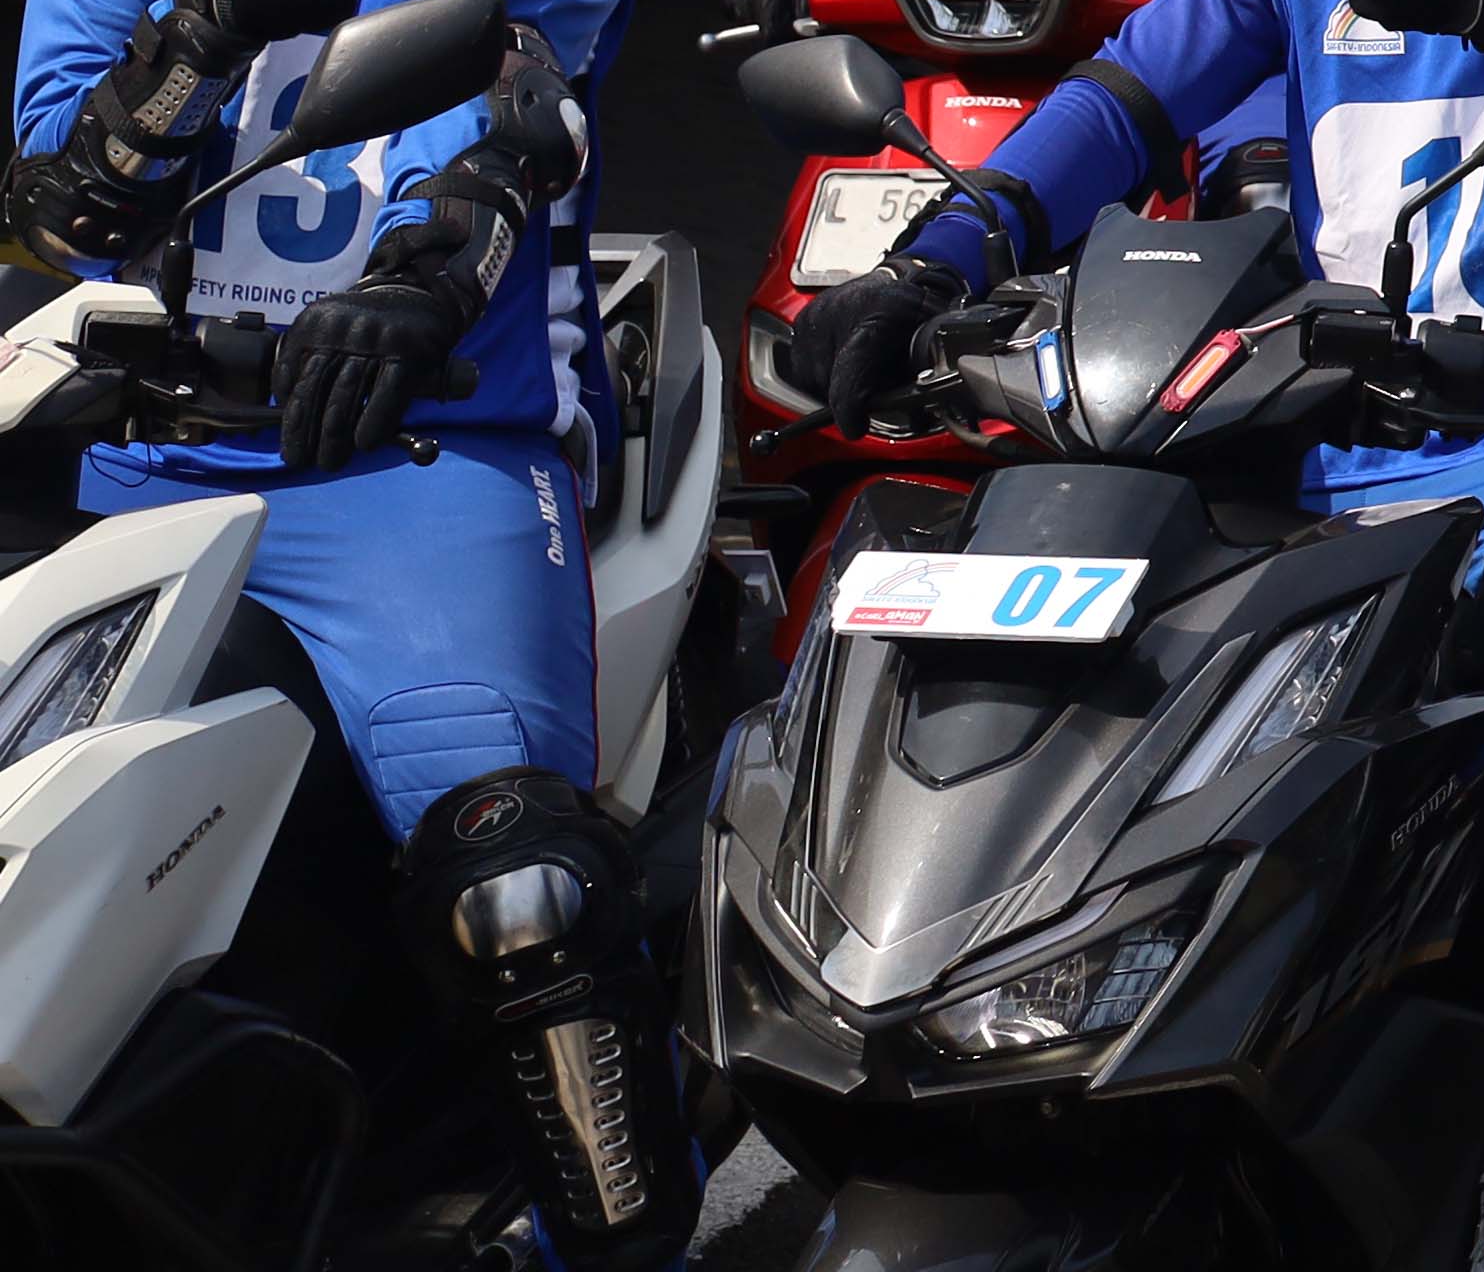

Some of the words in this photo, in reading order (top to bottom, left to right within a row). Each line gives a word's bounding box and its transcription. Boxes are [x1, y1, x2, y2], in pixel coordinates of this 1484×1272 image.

[944, 96, 1023, 109] HONDA
[193, 34, 363, 263] 13
[824, 188, 846, 223] L
[1123, 250, 1202, 262] HONDA
[192, 277, 227, 299] FETY
[231, 283, 297, 305] RIDING
[991, 564, 1126, 628] 07
[146, 805, 226, 894] HONDA
